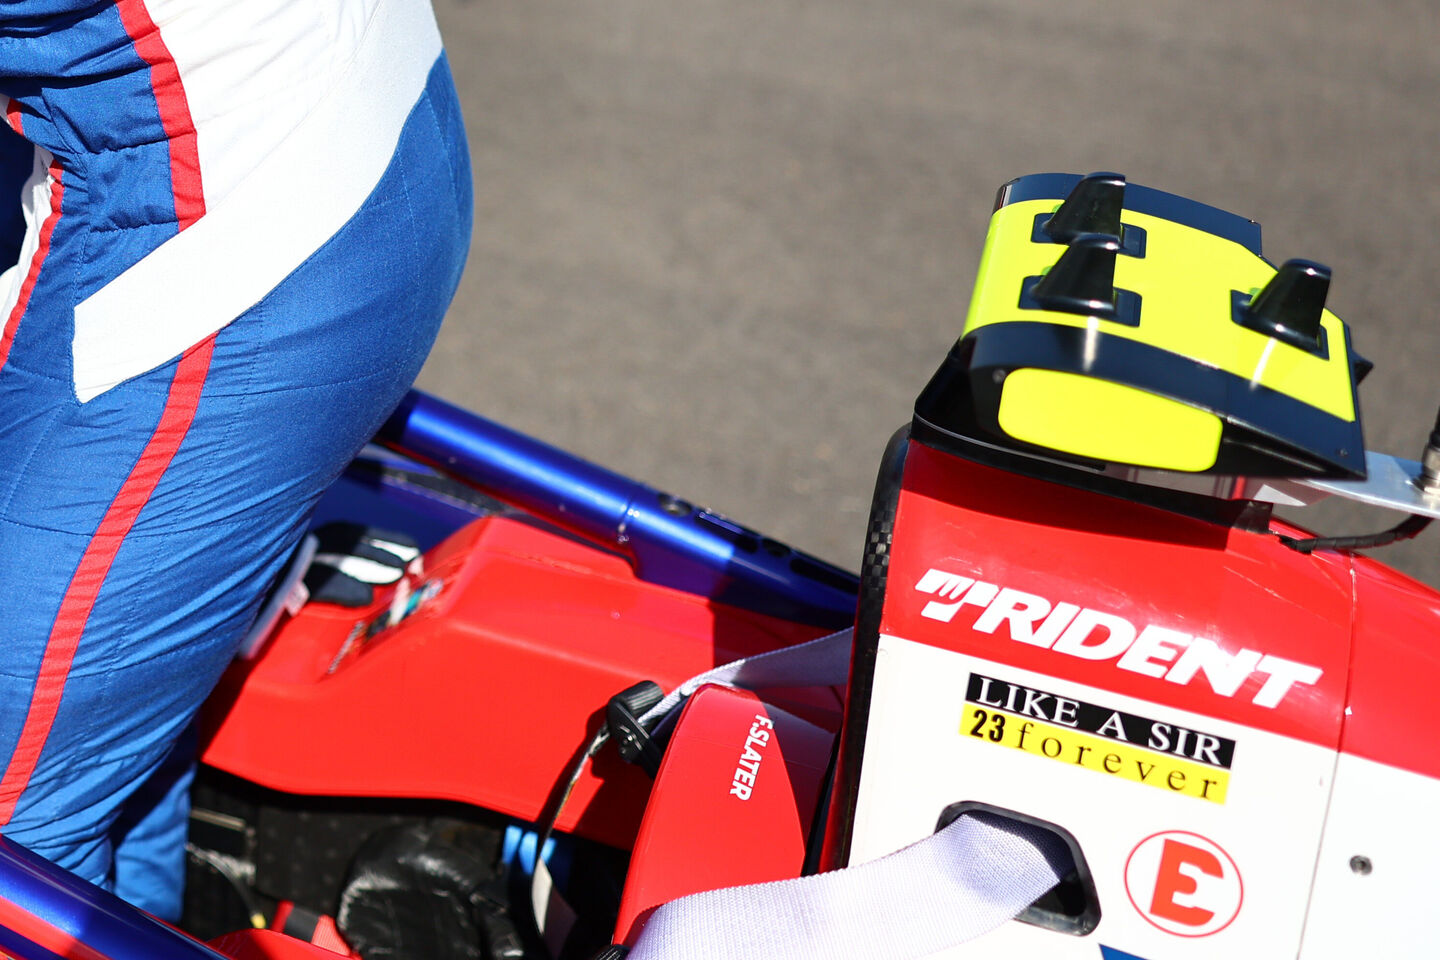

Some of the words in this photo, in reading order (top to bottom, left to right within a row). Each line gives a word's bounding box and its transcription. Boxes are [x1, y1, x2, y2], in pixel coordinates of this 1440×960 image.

[915, 568, 1323, 709] TRIDENT
[729, 714, 774, 801] F.SLATER
[975, 677, 1081, 728] LIKE
[1097, 712, 1130, 741] A
[1148, 723, 1224, 766] SIR
[1149, 838, 1224, 928] E
